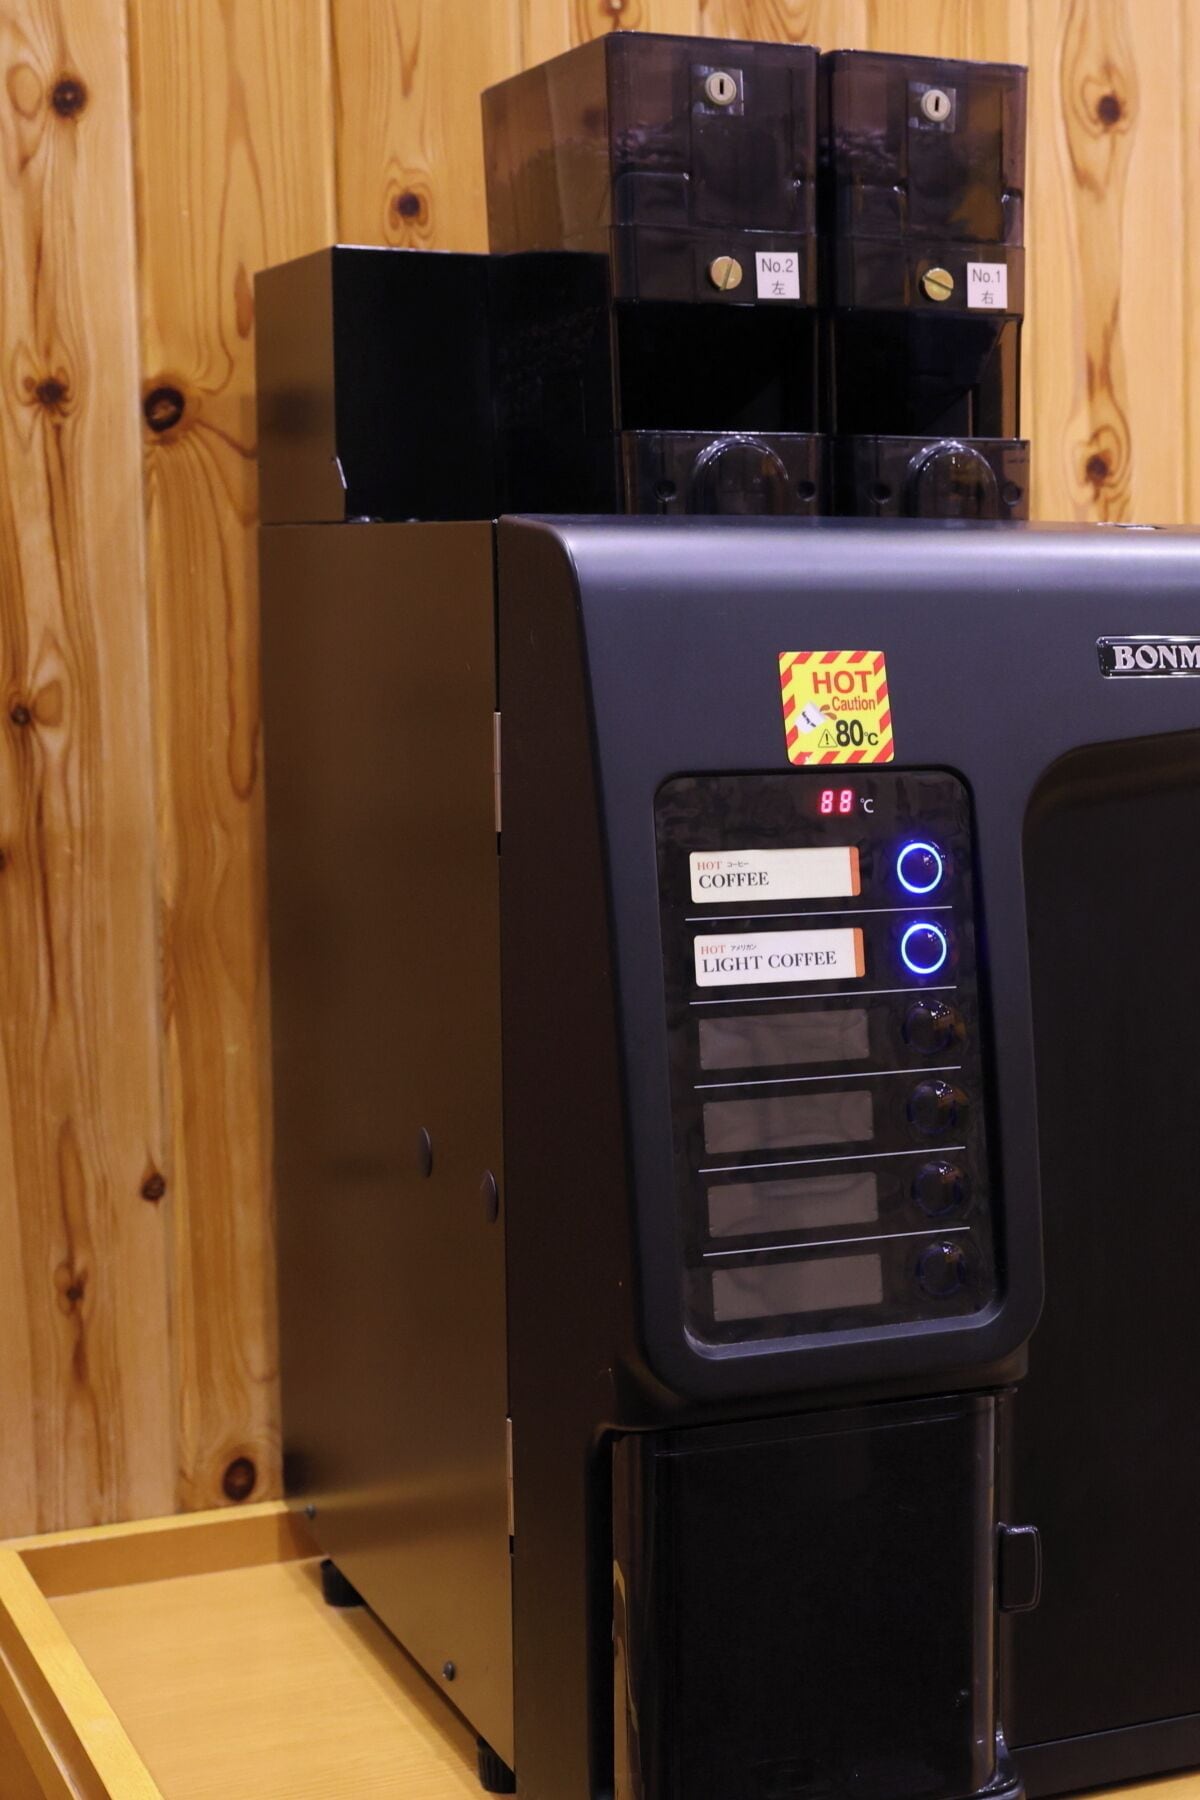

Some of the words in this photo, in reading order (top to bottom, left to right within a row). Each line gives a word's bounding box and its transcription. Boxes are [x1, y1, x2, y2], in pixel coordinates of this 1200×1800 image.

[761, 259, 793, 274] No.2
[972, 269, 1002, 284] No.1
[772, 280, 786, 296] 左
[981, 290, 995, 305] 右
[812, 670, 872, 694] HOT
[832, 695, 876, 711] Caution
[821, 789, 853, 813] 88
[697, 861, 723, 871] HOT
[698, 871, 769, 889] COFFEE
[700, 944, 726, 955] HOT
[703, 955, 763, 973] LIGHT
[768, 950, 837, 969] COFFEE
